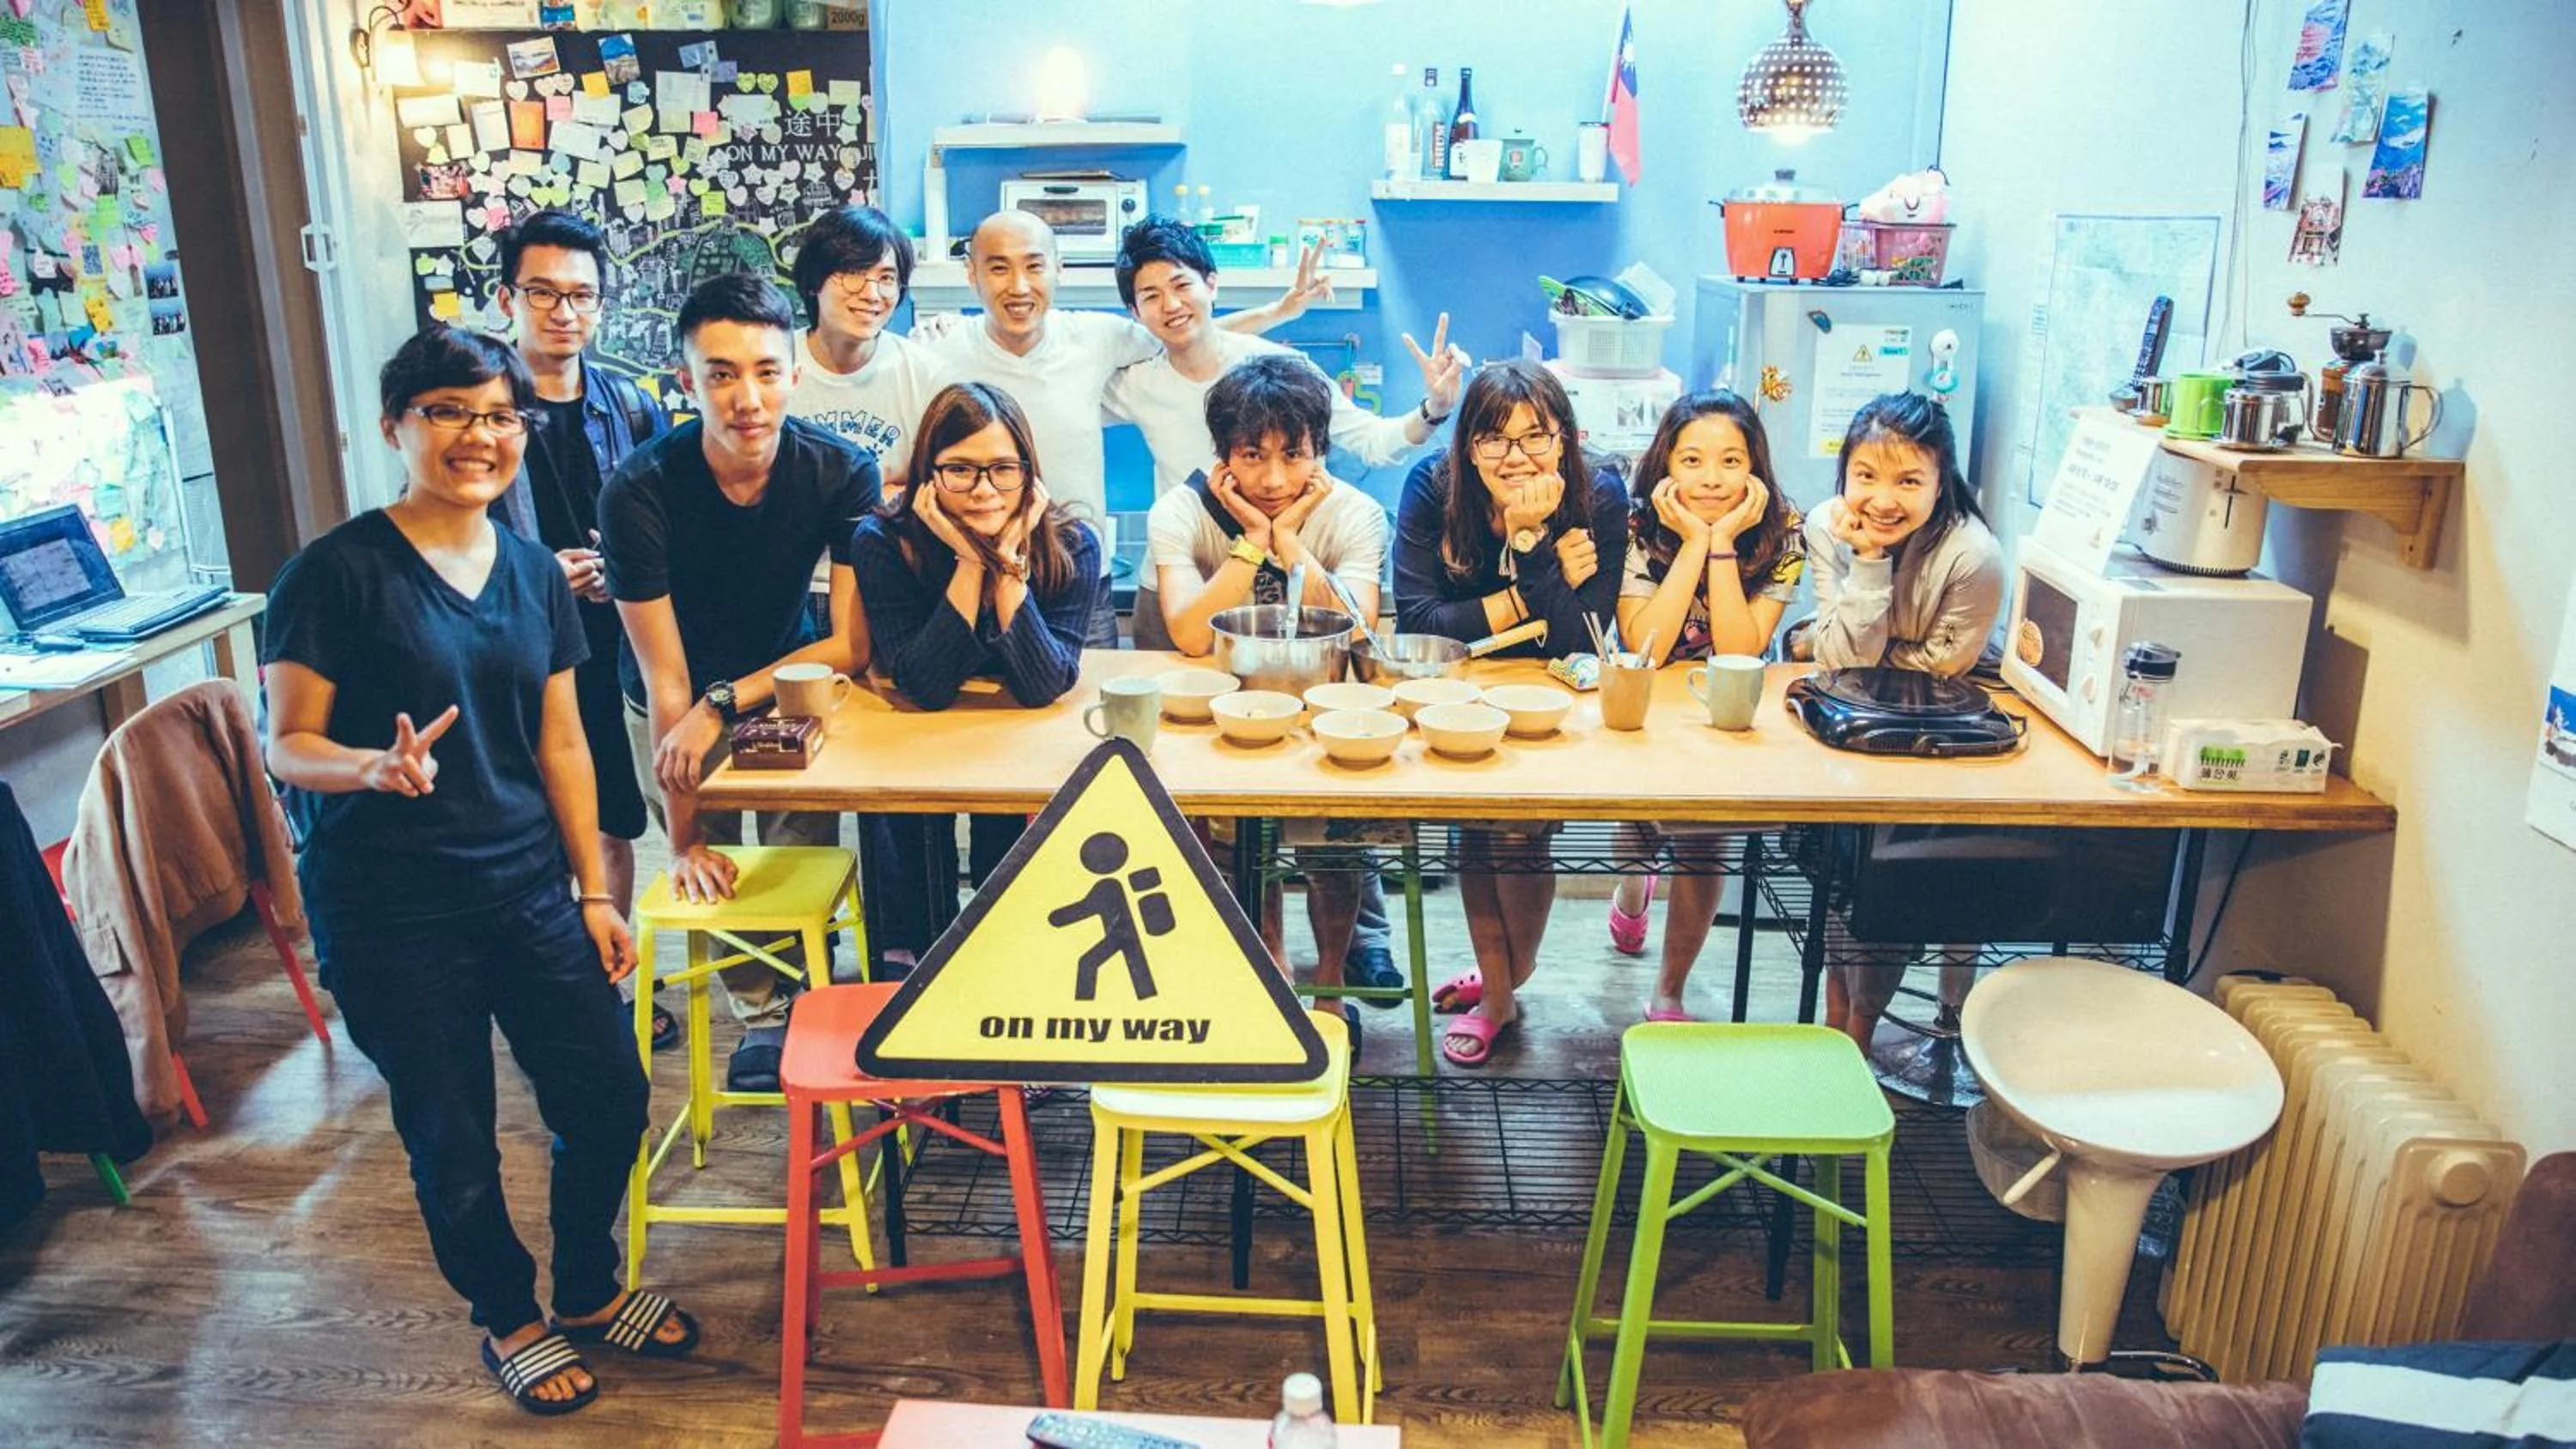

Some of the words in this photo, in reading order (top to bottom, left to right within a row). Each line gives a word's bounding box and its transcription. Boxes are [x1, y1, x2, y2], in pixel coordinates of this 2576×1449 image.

[830, 10, 865, 27] 2000g
[784, 110, 840, 136] 途中
[727, 145, 753, 161] ON
[761, 144, 789, 161] MY
[795, 144, 841, 161] WAY
[980, 1016, 1034, 1039] on
[1045, 1017, 1112, 1042] my
[1122, 1018, 1211, 1044] way
